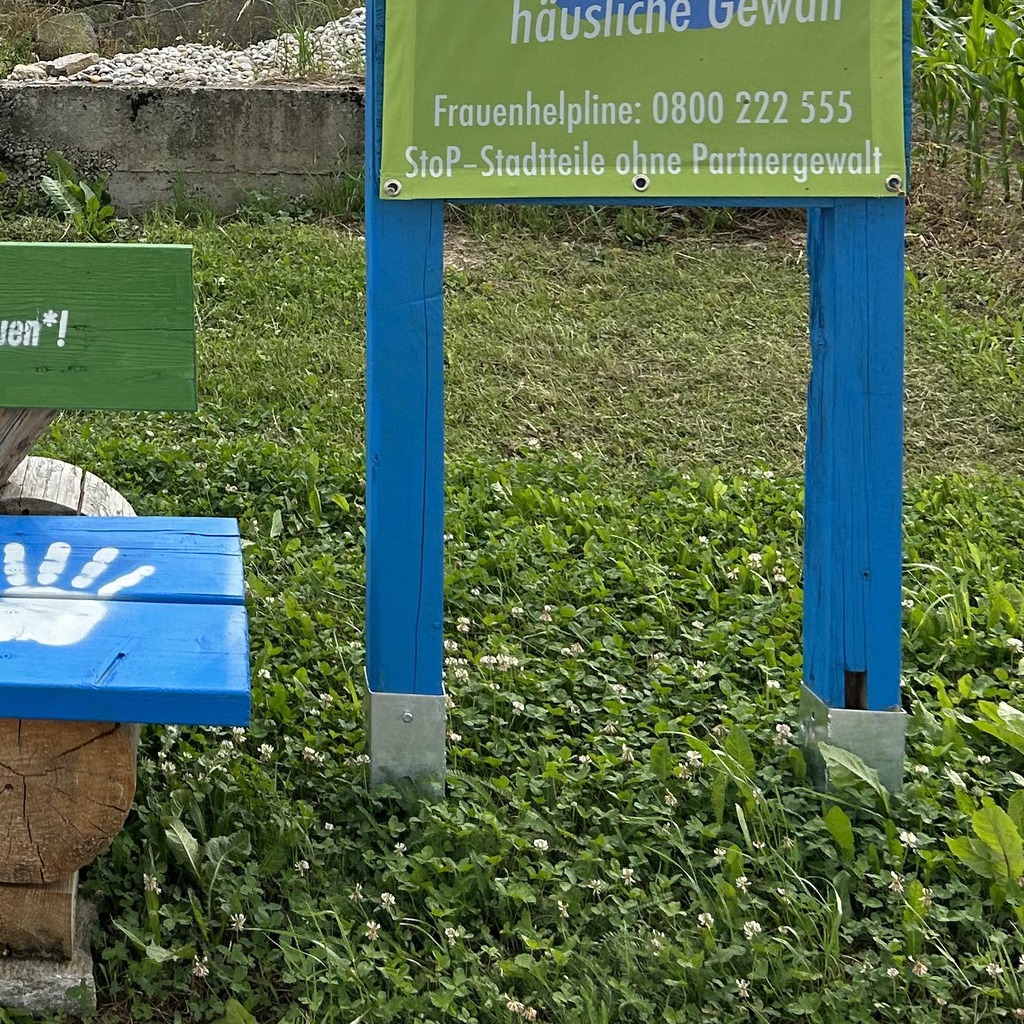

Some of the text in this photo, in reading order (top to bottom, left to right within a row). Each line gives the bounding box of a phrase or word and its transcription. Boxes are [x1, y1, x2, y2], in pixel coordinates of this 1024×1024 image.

[433, 89, 854, 134] Frauenhelpline: 0800 222 555
[615, 140, 682, 176] ohne
[692, 139, 883, 183] Partnergewalt
